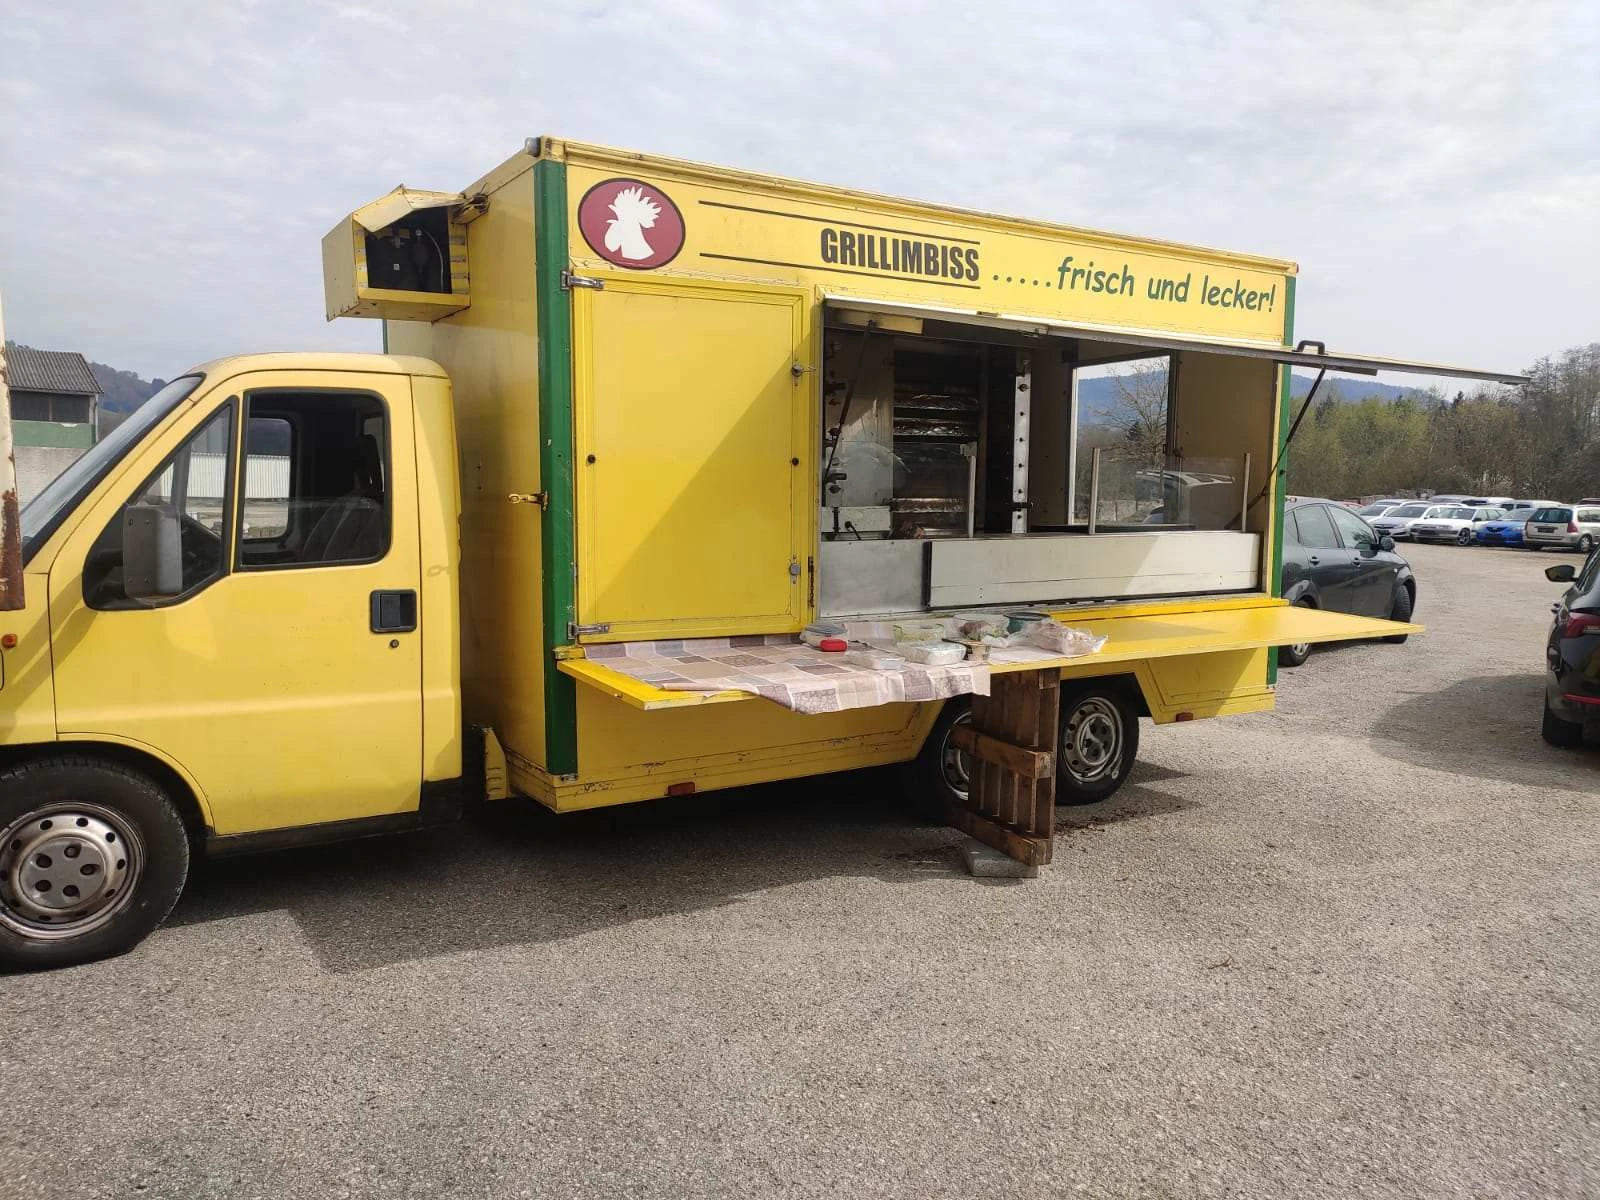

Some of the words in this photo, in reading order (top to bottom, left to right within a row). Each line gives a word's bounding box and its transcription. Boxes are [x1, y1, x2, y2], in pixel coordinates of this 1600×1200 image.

[820, 228, 980, 281] GRILLIMBISS
[1147, 273, 1190, 303] und
[1201, 275, 1276, 313] lecker!
